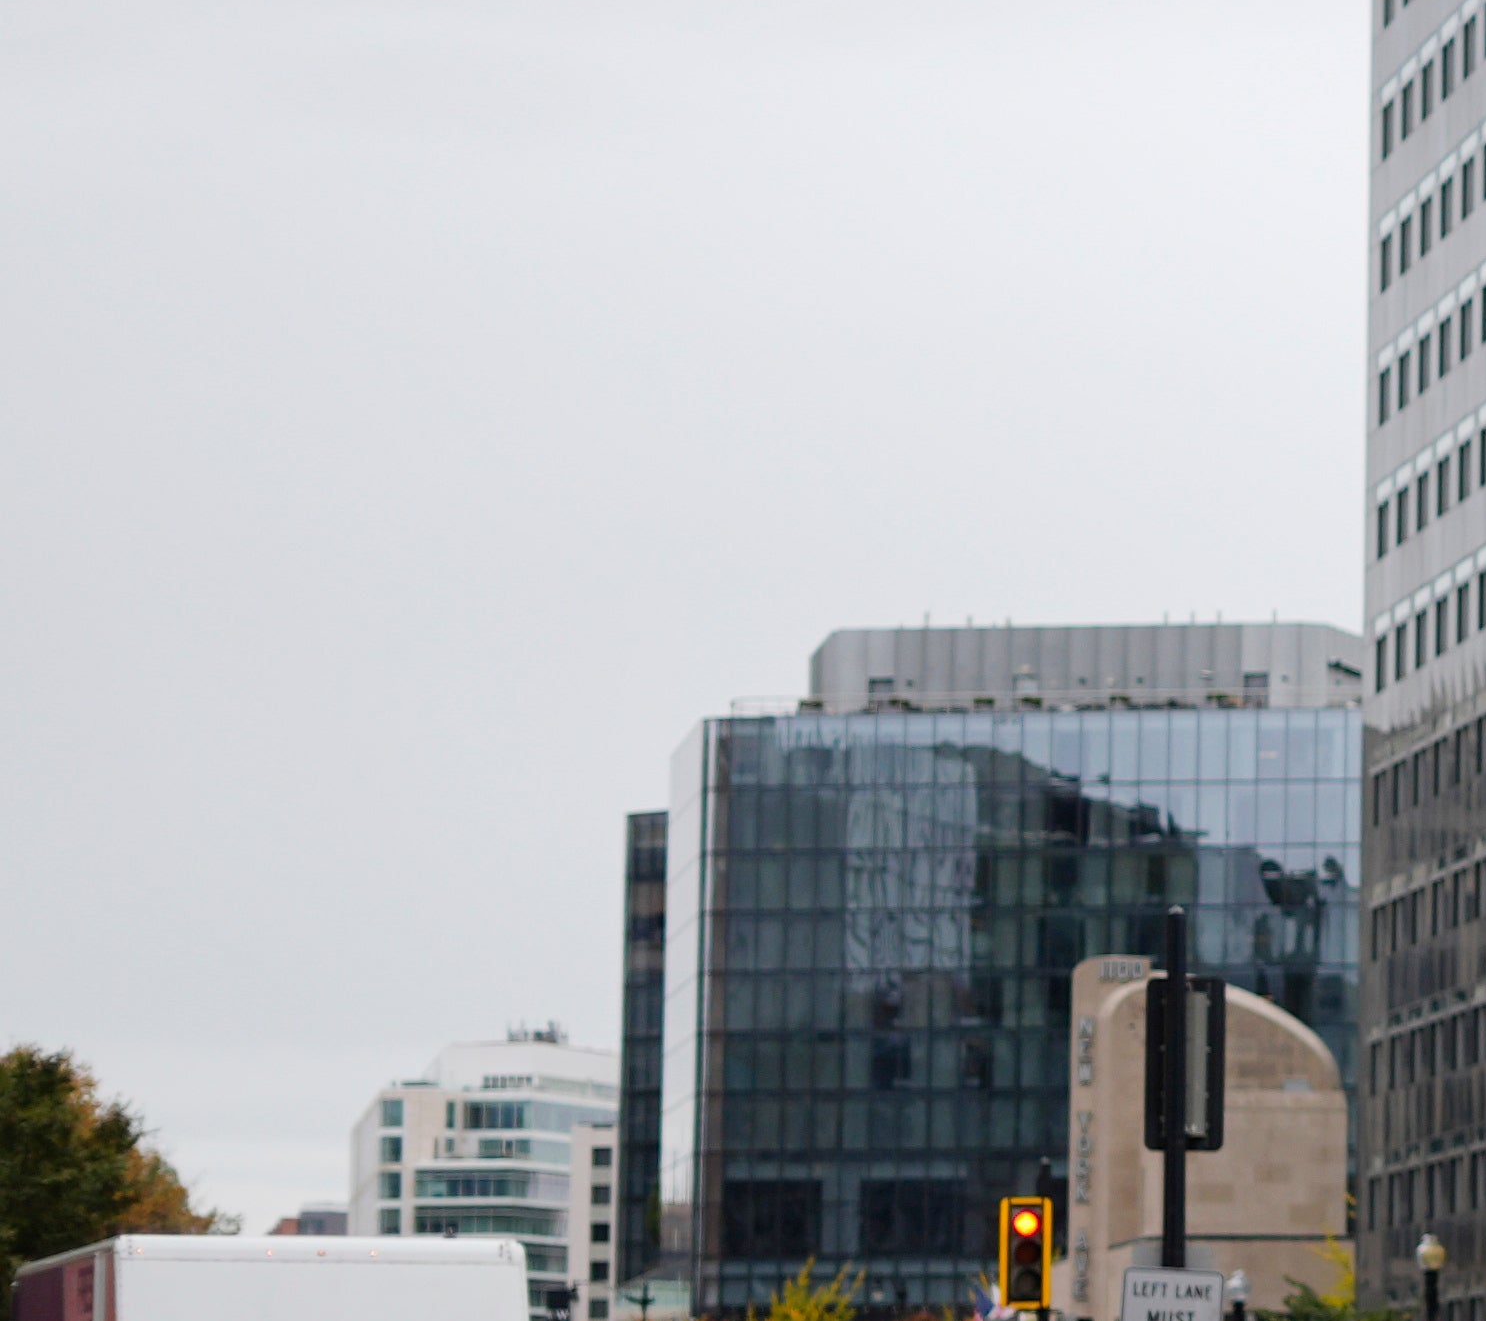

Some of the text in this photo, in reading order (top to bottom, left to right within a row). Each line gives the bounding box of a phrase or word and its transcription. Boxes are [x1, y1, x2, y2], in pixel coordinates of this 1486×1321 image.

[1099, 960, 1144, 979] 1100
[1076, 1111, 1093, 1205] YORK
[1133, 1281, 1212, 1301] LEFT LANE
